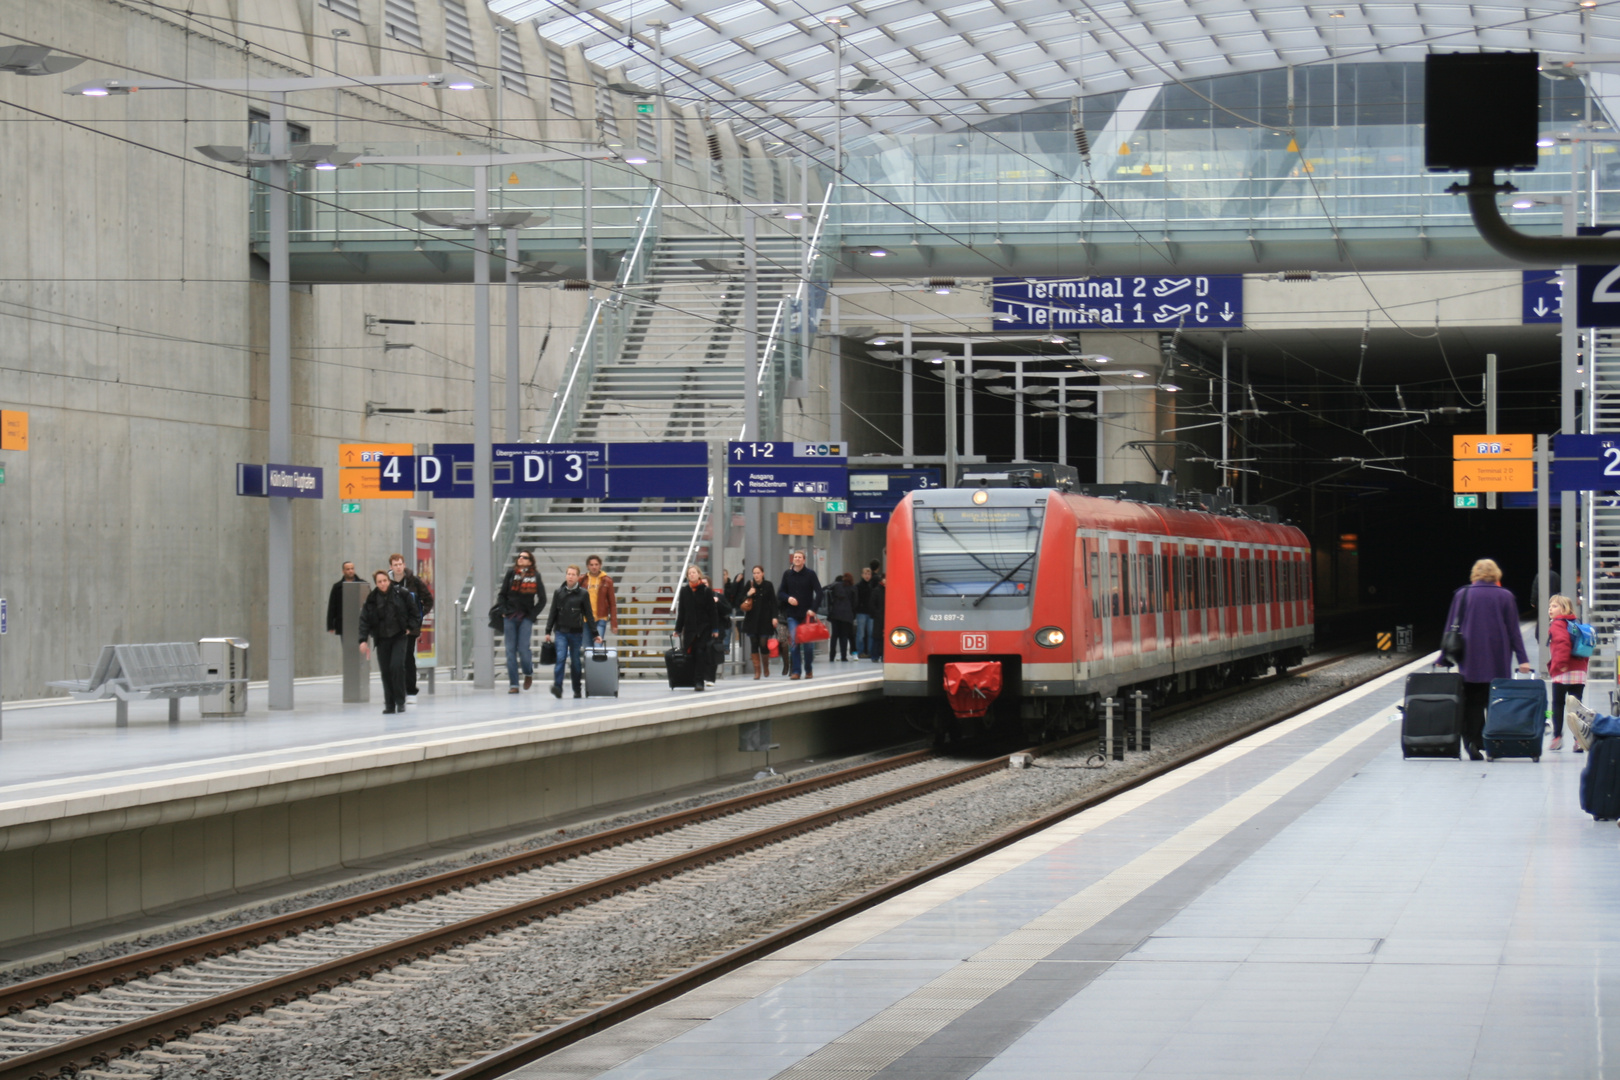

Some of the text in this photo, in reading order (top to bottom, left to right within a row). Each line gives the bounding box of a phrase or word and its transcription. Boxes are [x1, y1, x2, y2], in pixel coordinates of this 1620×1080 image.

[1024, 276, 1209, 299] Terminal 2 D
[1023, 302, 1209, 325] Terminal 1 C
[749, 442, 774, 458] 1-2
[1603, 447, 1620, 476] 2
[382, 456, 442, 484] 4 D
[524, 454, 583, 482] D 3
[749, 473, 774, 481] Ausgang
[919, 476, 928, 489] 3
[964, 635, 985, 649] DB
